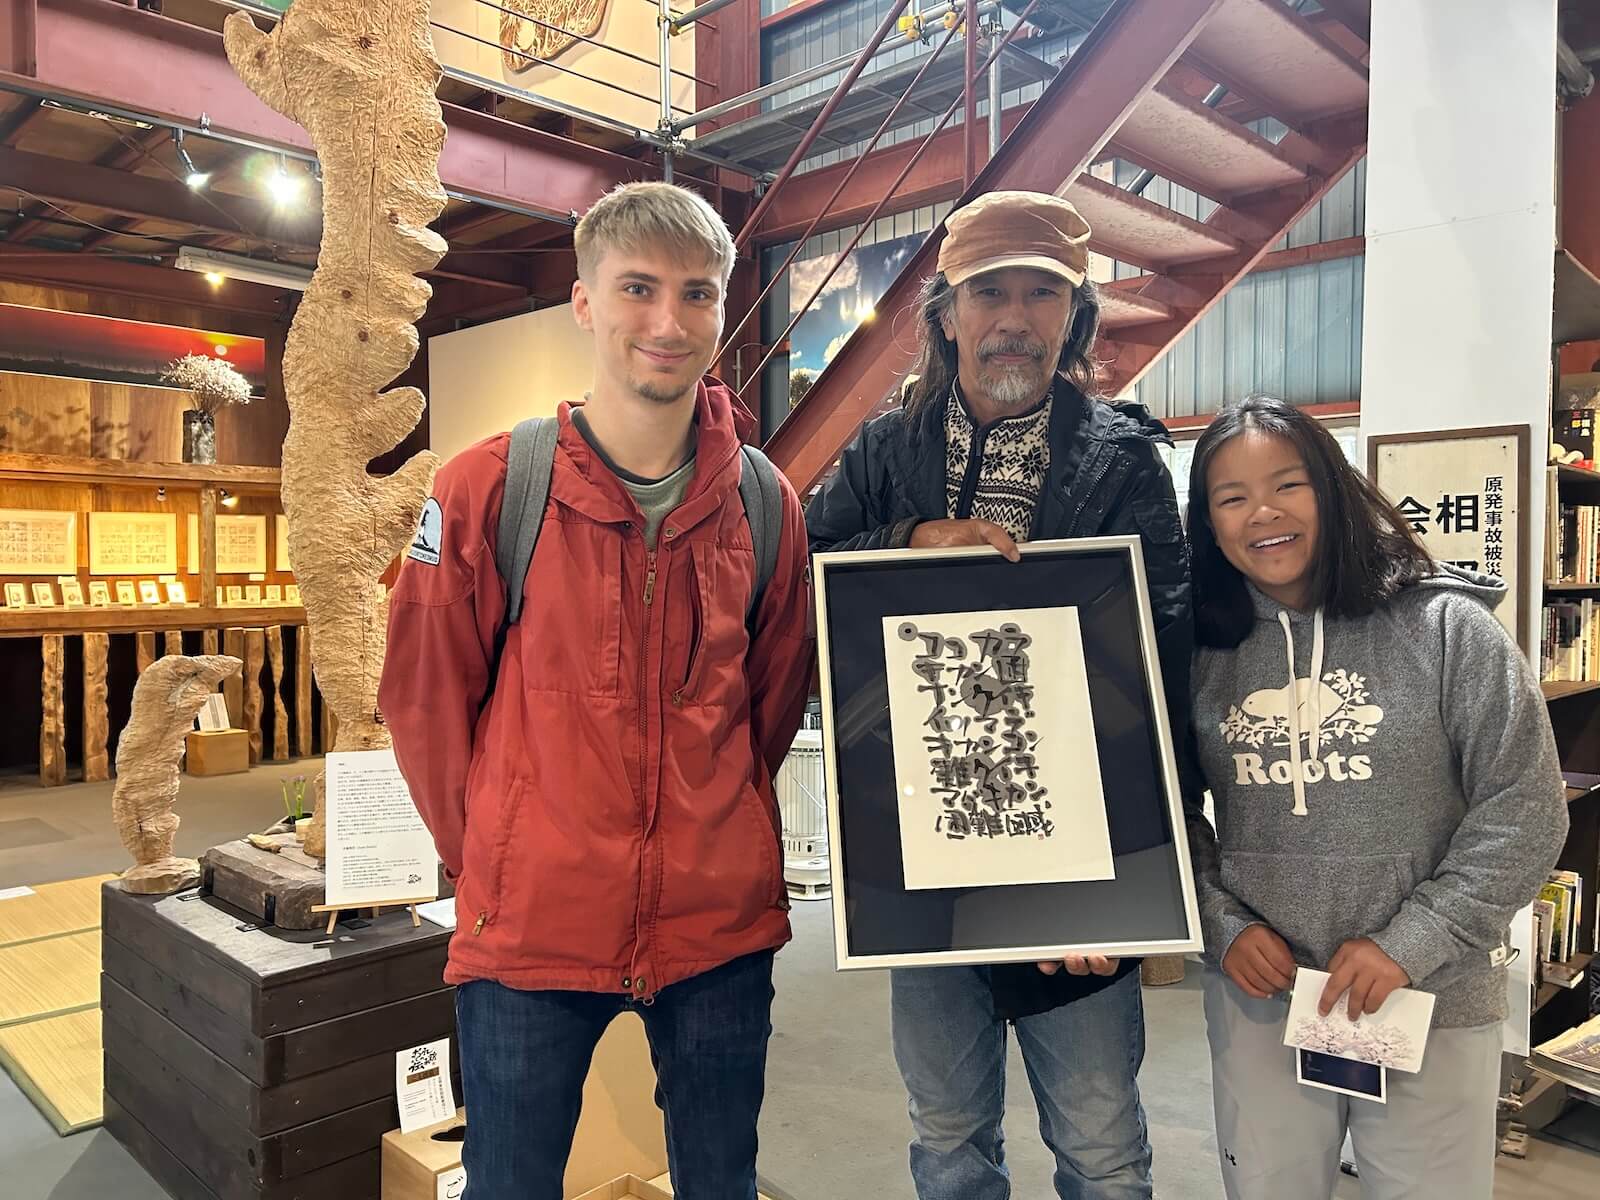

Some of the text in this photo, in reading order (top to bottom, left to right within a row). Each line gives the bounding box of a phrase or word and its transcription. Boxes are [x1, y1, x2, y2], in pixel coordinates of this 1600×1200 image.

[1484, 476, 1503, 577] 原発事故被災
[1232, 751, 1373, 785] Roots
